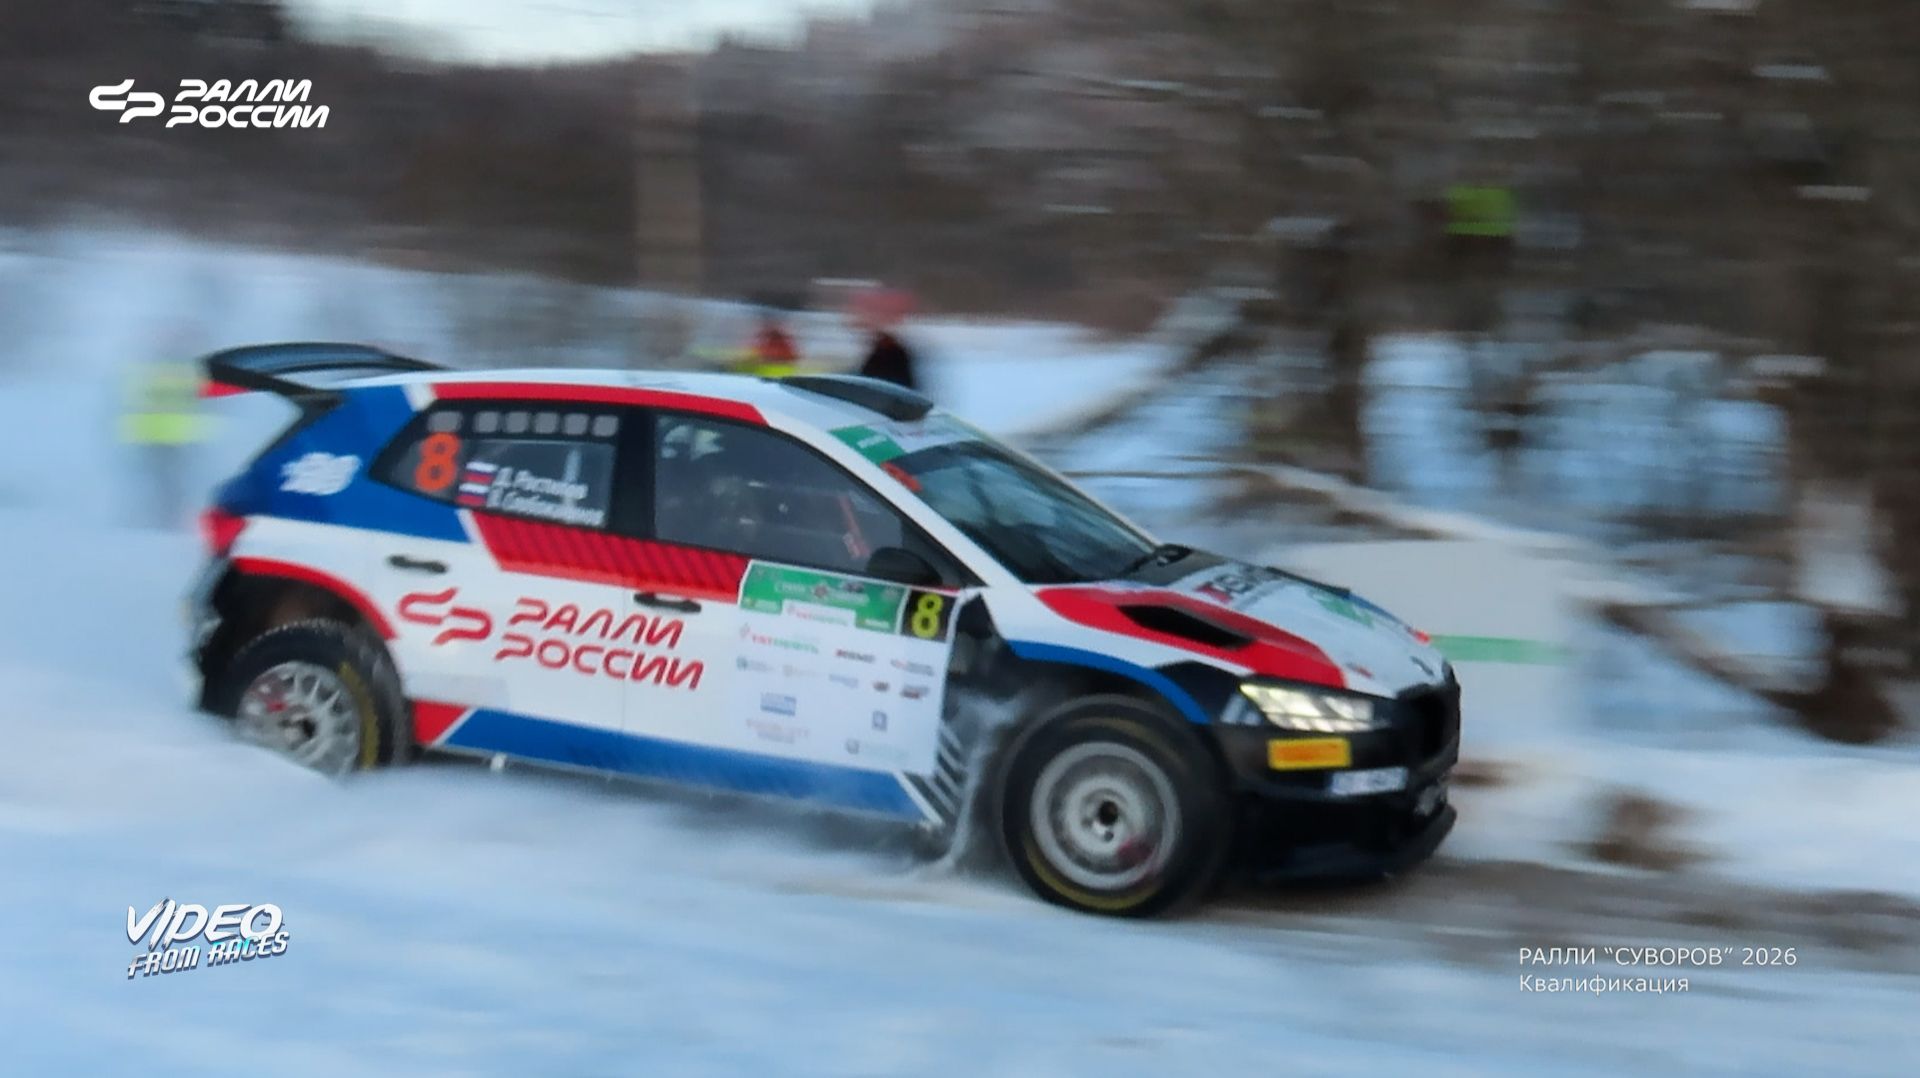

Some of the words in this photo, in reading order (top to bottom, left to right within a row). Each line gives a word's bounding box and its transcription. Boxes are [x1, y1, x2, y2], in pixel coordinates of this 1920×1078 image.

[414, 432, 461, 492] 8
[508, 597, 685, 649] РАЛЛИ
[911, 592, 943, 640] 8
[494, 632, 705, 690] РОССИИ
